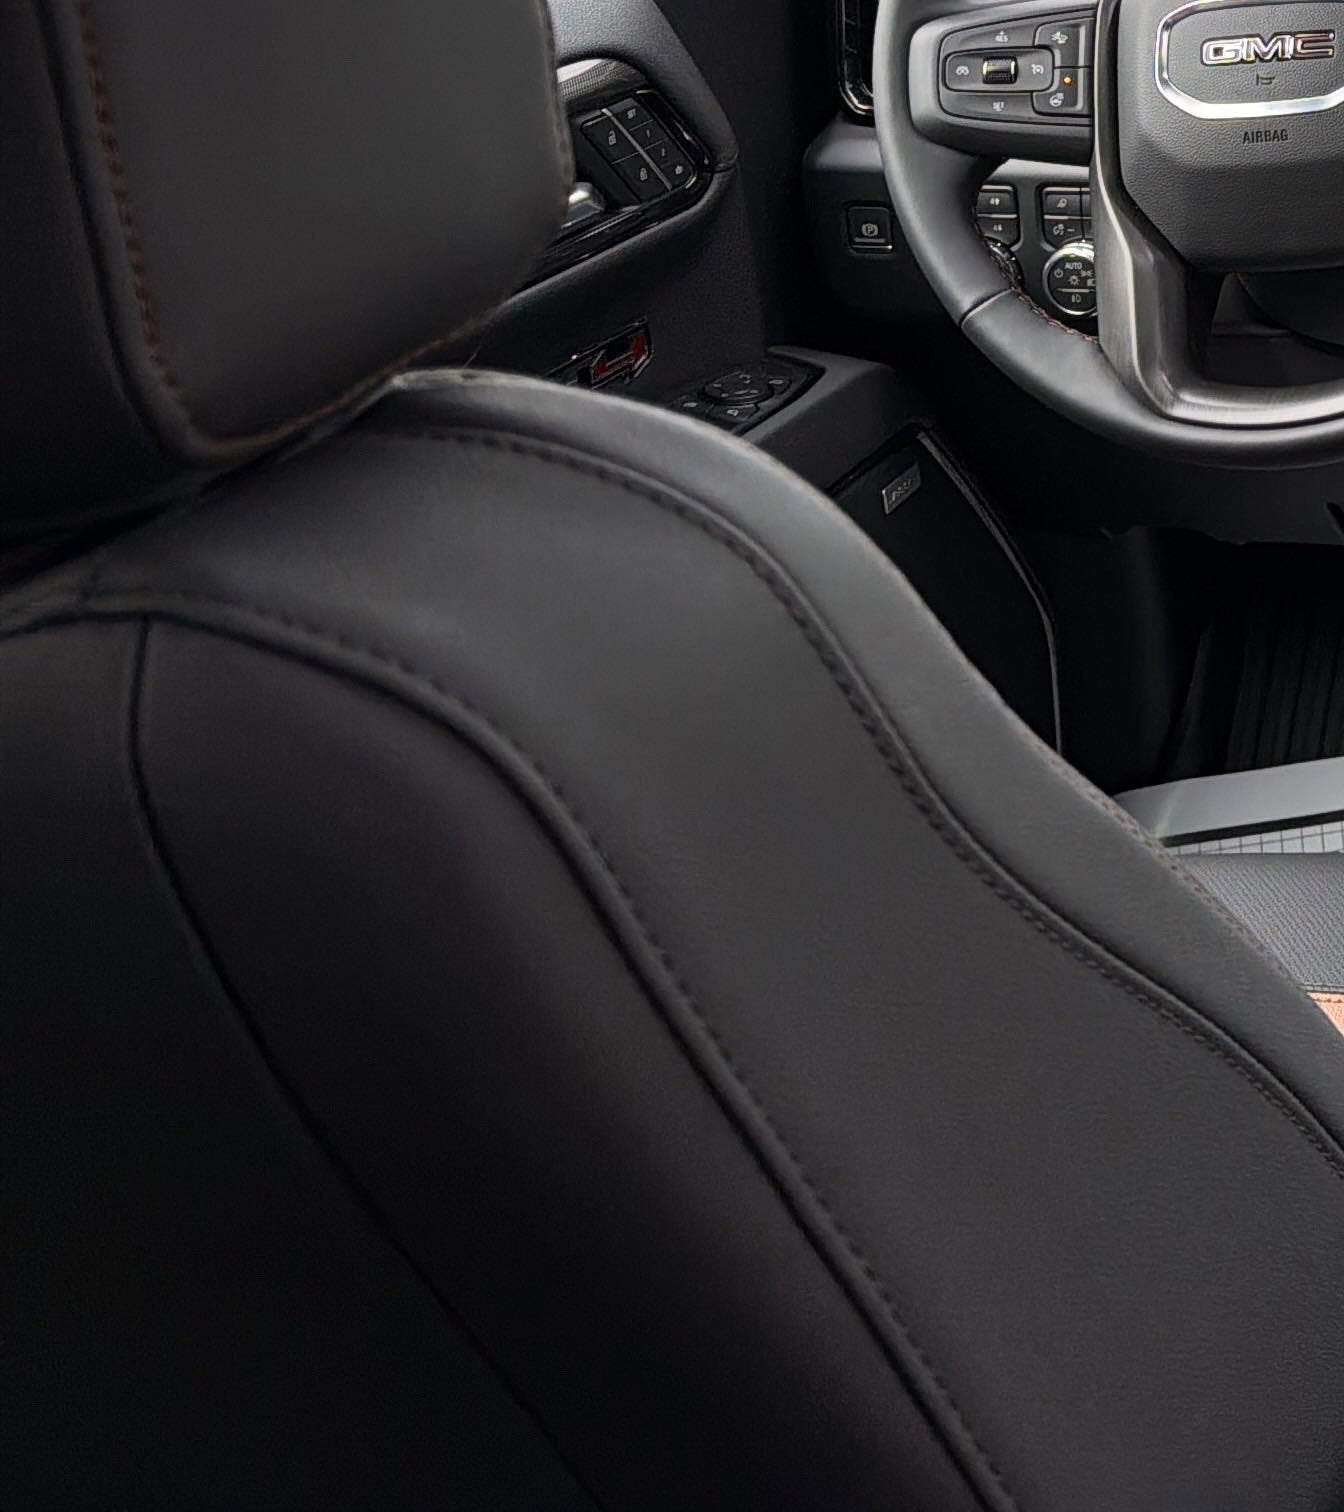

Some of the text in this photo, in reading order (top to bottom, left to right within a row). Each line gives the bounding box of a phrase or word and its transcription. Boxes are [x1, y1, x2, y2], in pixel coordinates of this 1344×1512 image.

[1202, 30, 1336, 65] GMC
[1242, 128, 1289, 144] AIRBAG
[1065, 262, 1083, 270] AUTO
